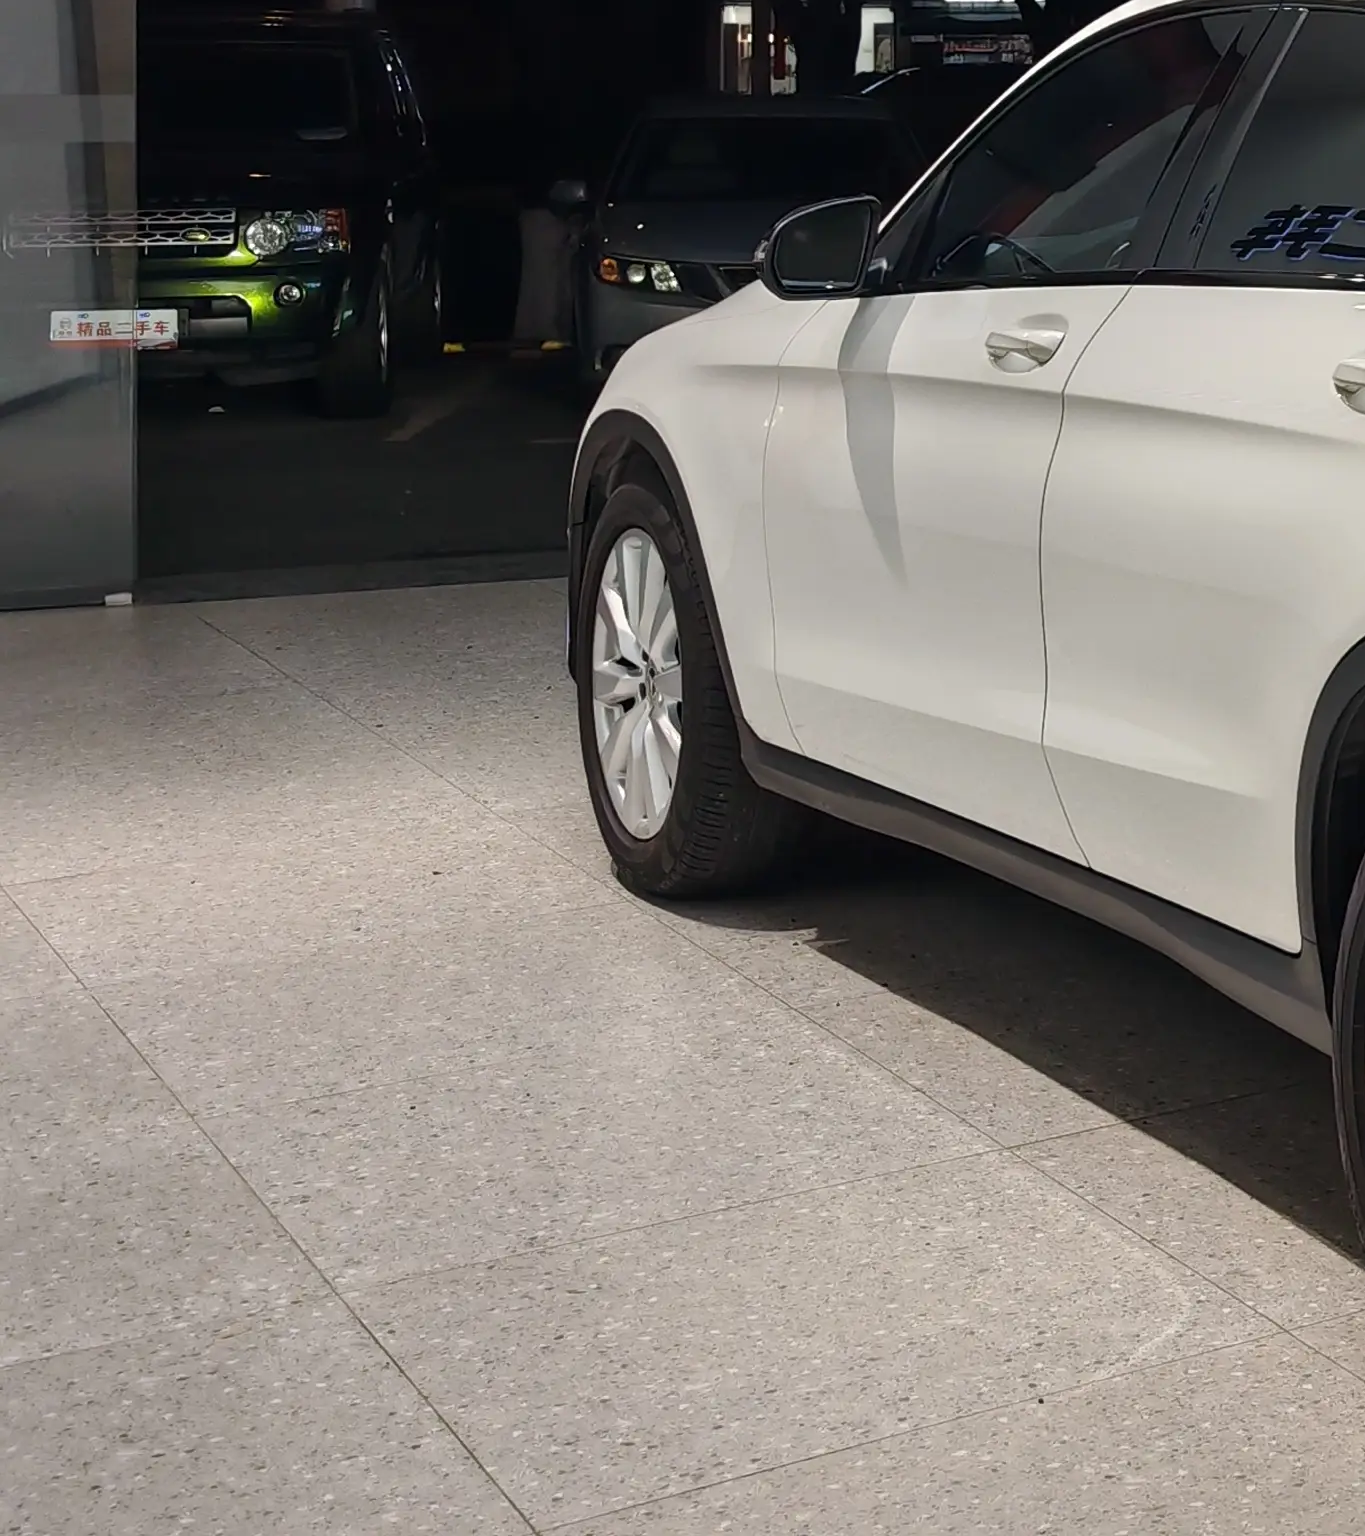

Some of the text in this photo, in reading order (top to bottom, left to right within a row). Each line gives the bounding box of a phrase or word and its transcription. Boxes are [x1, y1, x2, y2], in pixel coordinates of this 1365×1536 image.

[76, 320, 170, 337] 精品二手车
